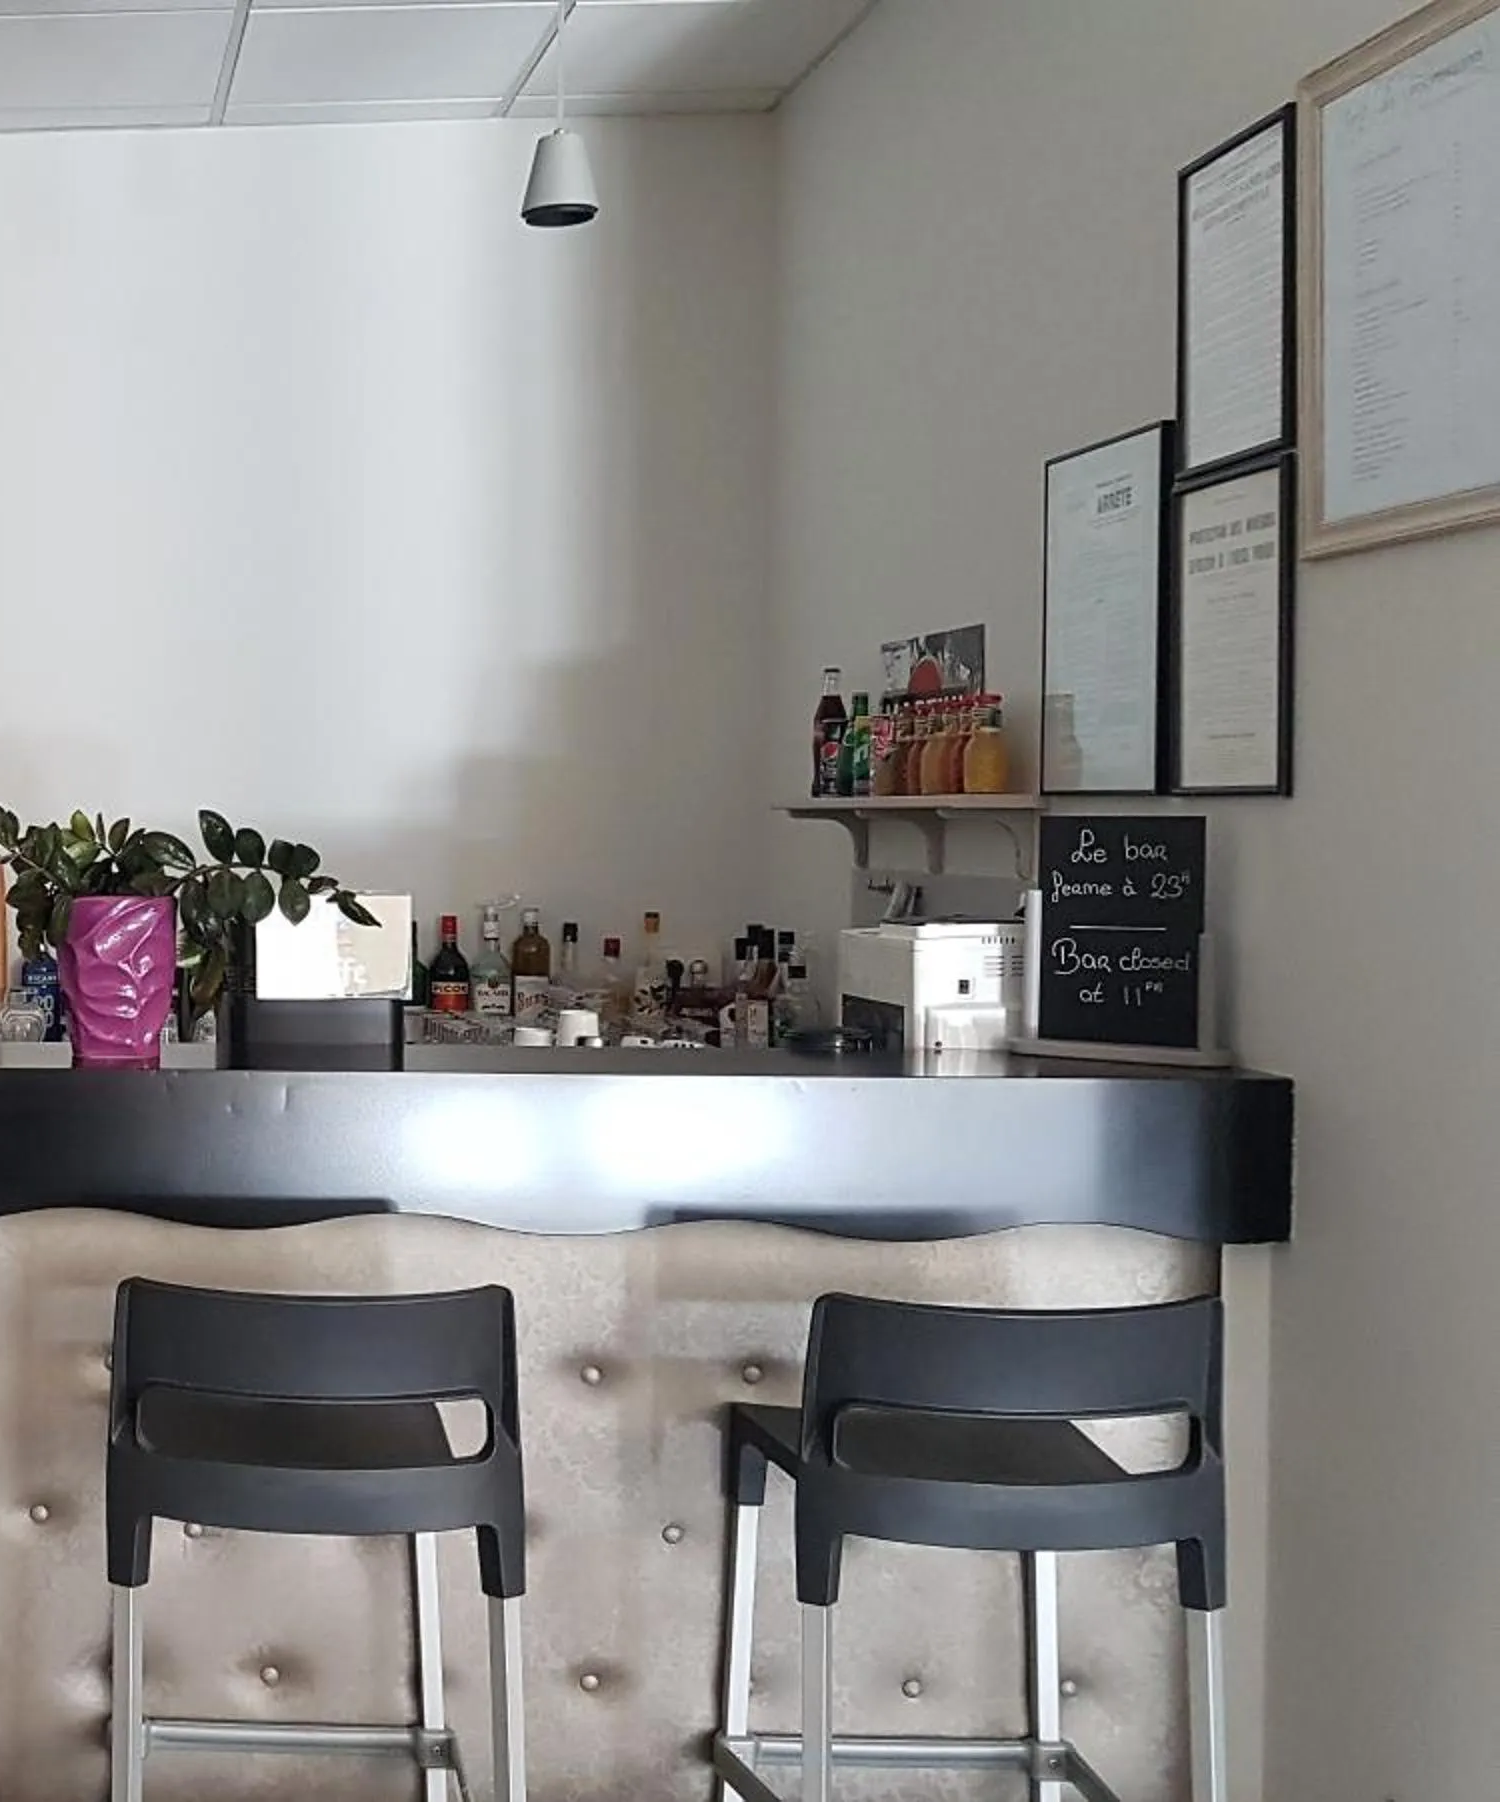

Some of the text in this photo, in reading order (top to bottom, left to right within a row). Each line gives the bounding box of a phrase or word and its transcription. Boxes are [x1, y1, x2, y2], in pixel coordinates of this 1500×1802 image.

[1071, 829, 1108, 863] Le
[1123, 876, 1138, 897] à
[1051, 937, 1191, 976] Bar closed
[1079, 982, 1105, 1004] at
